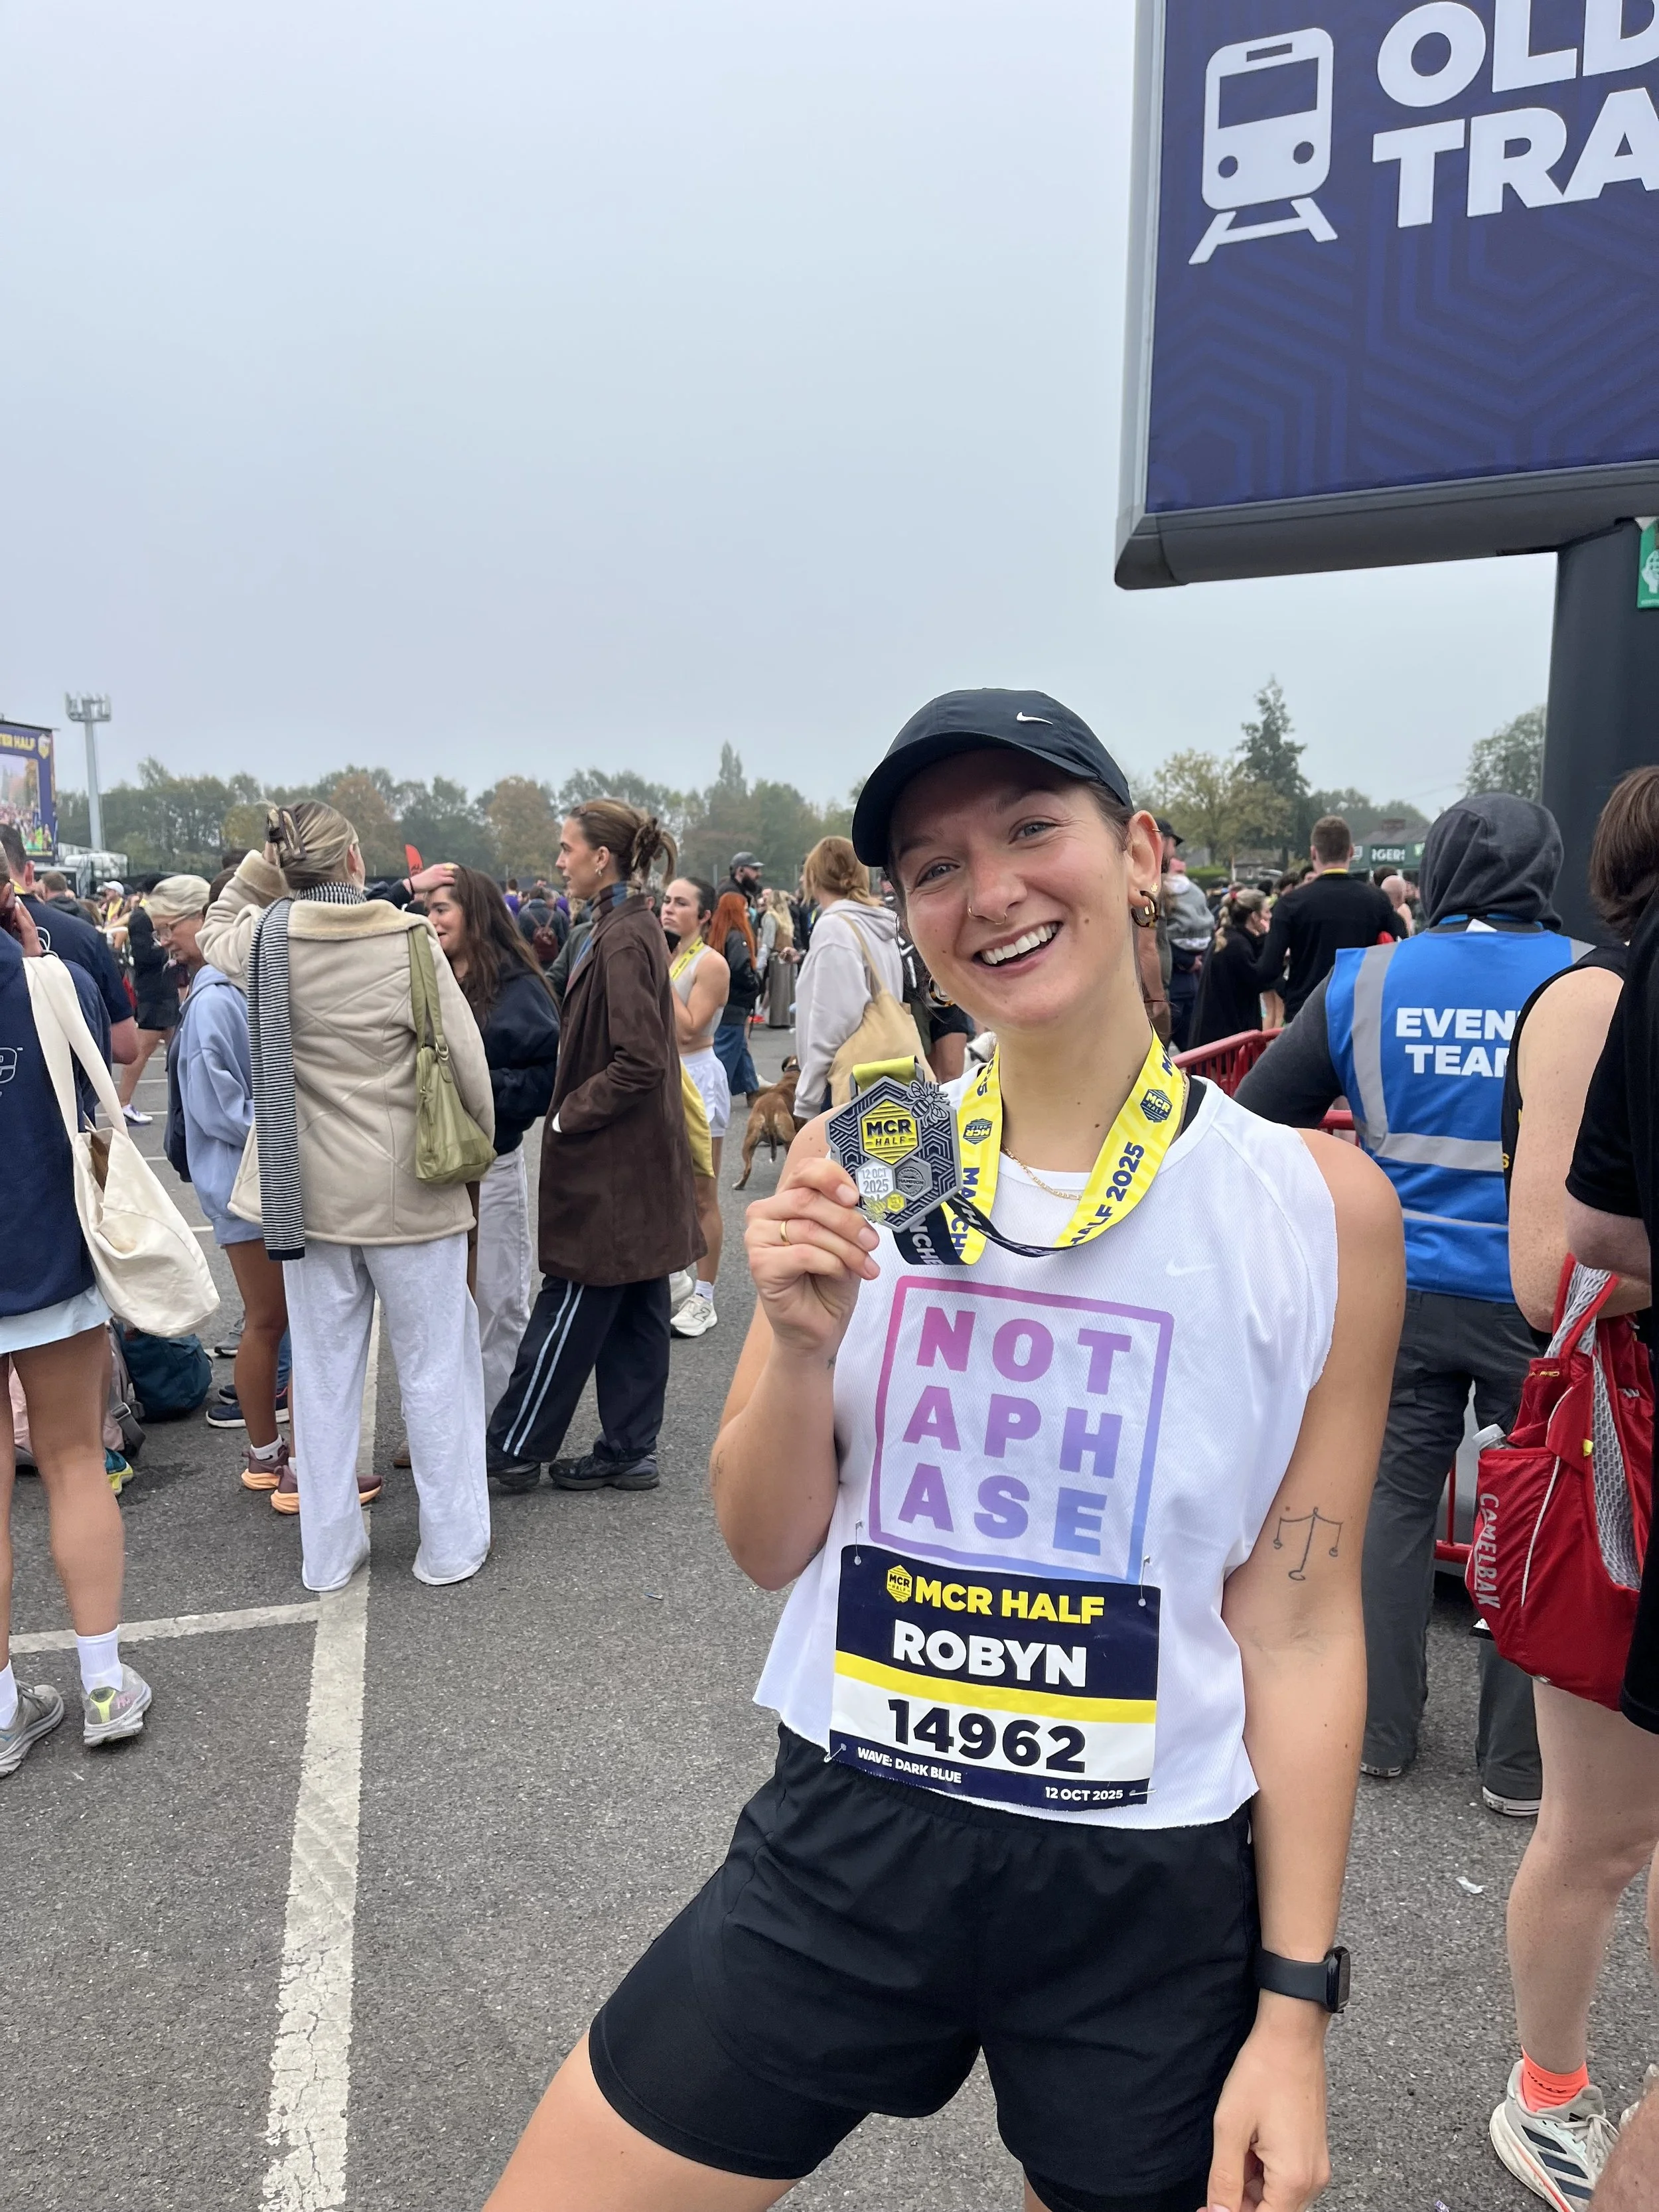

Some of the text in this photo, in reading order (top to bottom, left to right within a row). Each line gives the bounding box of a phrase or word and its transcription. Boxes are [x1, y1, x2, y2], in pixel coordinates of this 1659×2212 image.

[1376, 0, 1659, 108] OLD
[1372, 87, 1659, 229] TRA
[1396, 1007, 1522, 1041] EVEN
[1145, 1091, 1171, 1113] MCR
[866, 1119, 912, 1138] MCR
[875, 1136, 906, 1146] HALF
[965, 1128, 990, 1138] MCR
[863, 1179, 889, 1194] 2025
[871, 1167, 887, 1178] OCT
[1106, 1141, 1145, 1202] 2025
[916, 1306, 1132, 1395] NOT
[902, 1385, 1123, 1479] APH
[898, 1462, 1108, 1556] ASE
[1476, 1493, 1501, 1609] CAMELBAK
[889, 1574, 910, 1587] MCR
[915, 1575, 1104, 1624] MCR HALF
[893, 1619, 1087, 1688] ROBYN
[888, 1699, 1086, 1773] 14962
[857, 1747, 962, 1784] WAVE: DARK BLUE
[1045, 1786, 1123, 1801] 12 OCT 2025
